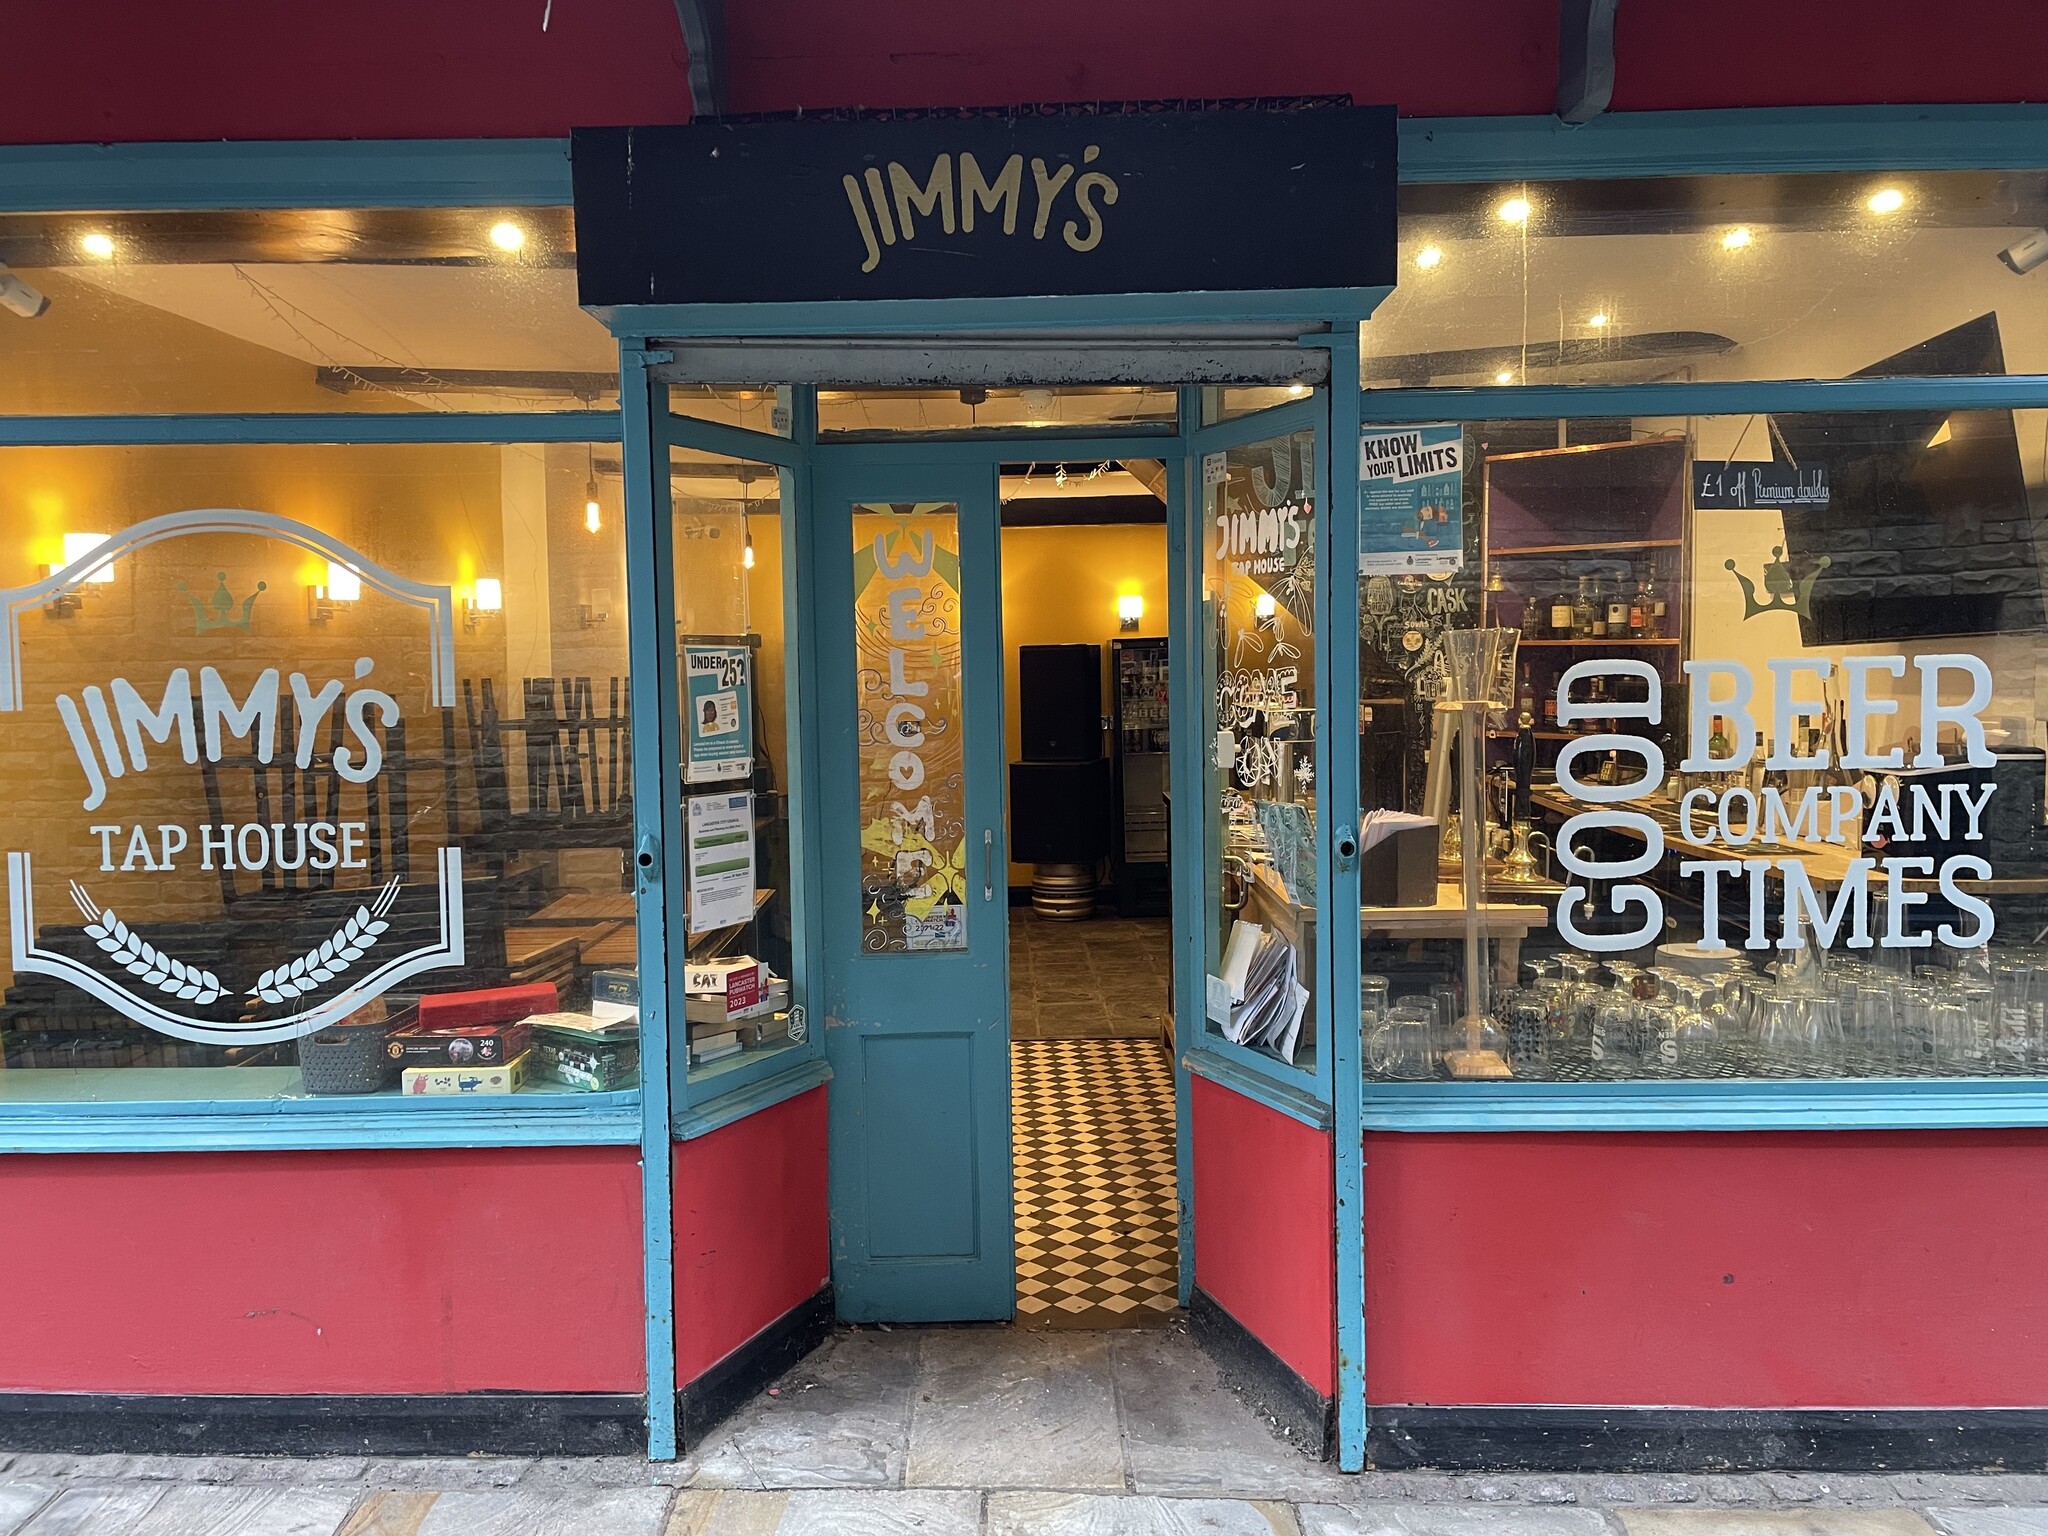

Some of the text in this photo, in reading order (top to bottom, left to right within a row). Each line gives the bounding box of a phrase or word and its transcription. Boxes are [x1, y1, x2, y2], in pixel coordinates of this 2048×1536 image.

[842, 144, 1118, 273] JIMMY'S
[1364, 433, 1418, 461] KNOW
[1366, 447, 1458, 478] YOUR LIMITS
[1701, 467, 1830, 507] £1 off Premium doubles
[1254, 557, 1285, 575] HOUSE
[1427, 587, 1468, 615] CASK
[690, 654, 745, 687] UNDER 25?
[873, 528, 935, 900] WELCOME
[1138, 708, 1168, 718] BEC
[1680, 654, 1998, 772] BEER
[55, 656, 400, 811] JIMMY'S
[1555, 659, 1664, 952] GOOD
[1679, 783, 1998, 846] COMPANY
[90, 822, 367, 871] TAP HOUSE
[1680, 855, 1996, 951] TIMES
[728, 976, 756, 989] LANCASTER
[728, 984, 756, 996] PUBWATCH
[729, 996, 746, 1008] 2023
[480, 1039, 494, 1047] 240
